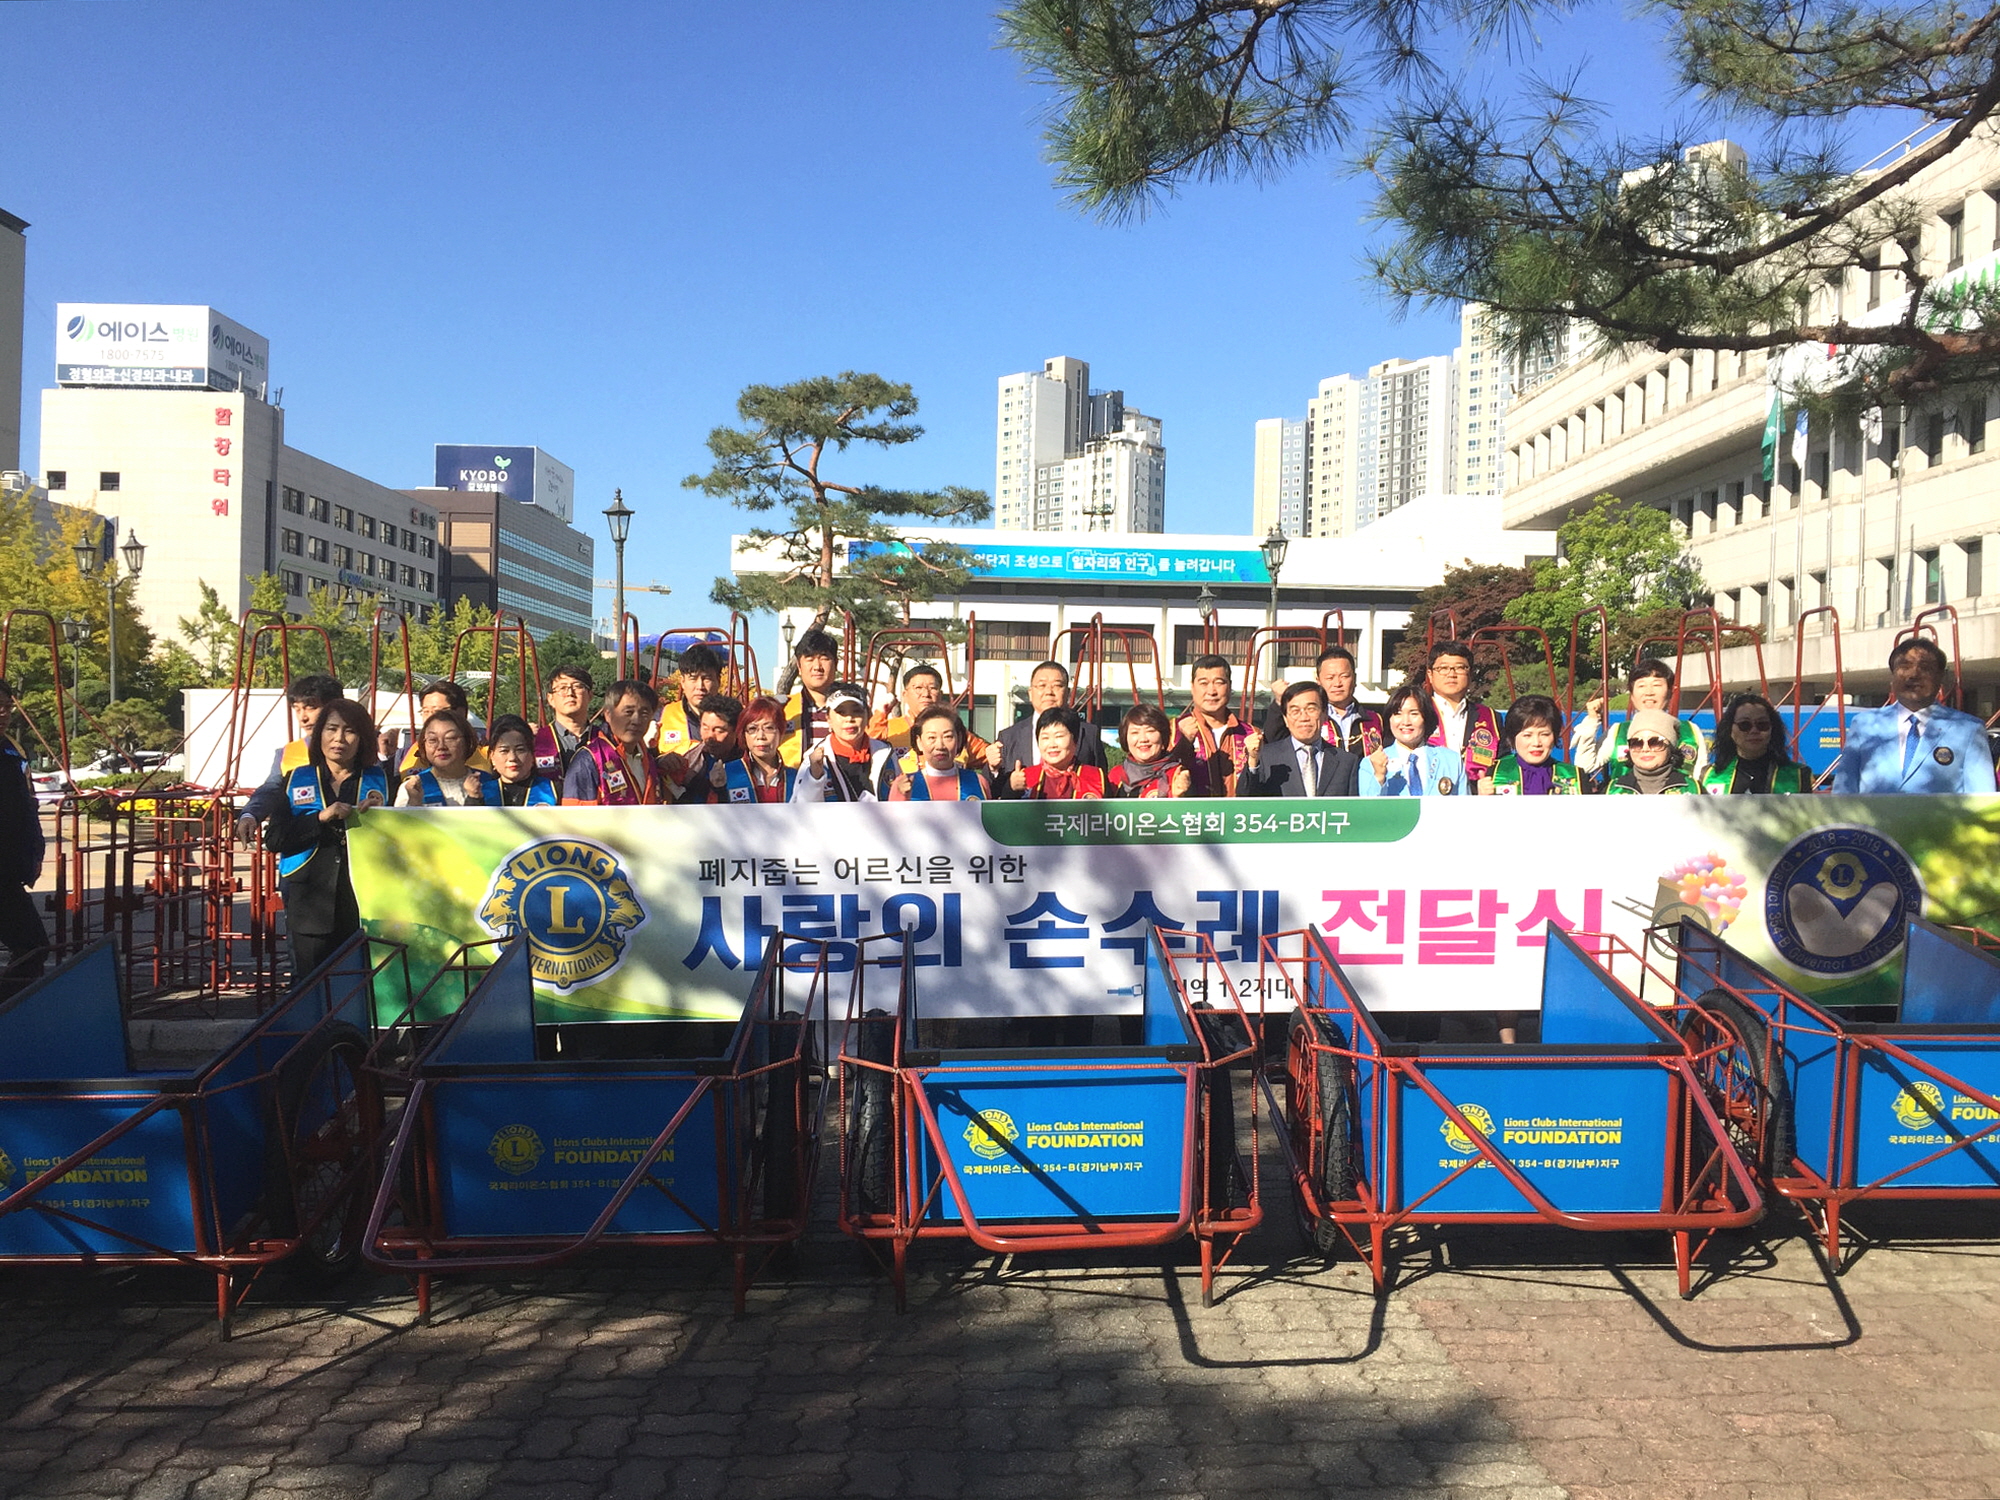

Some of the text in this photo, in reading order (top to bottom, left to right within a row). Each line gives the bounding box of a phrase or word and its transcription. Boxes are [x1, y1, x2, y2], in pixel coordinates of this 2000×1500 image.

[98, 321, 199, 342] 에이스 병원
[100, 349, 164, 361] 1800-7575
[225, 335, 253, 365] 에이스
[460, 469, 508, 482] KYOBO
[1014, 555, 1062, 570] 조성으로
[1072, 556, 1121, 571] 일자리와
[1125, 557, 1149, 571] 인구
[1158, 558, 1170, 571] 를
[1174, 558, 1236, 573] 늘려갑니다
[1045, 811, 1350, 838] 국제라이온스협회 354-B지구
[1805, 832, 1837, 853] 2018
[1851, 833, 1881, 853] 2019
[517, 846, 610, 877] LIONS
[698, 855, 1028, 888] 폐지줍는 어르신을 위한
[1767, 860, 1794, 907] District
[684, 888, 1604, 974] 사랑의 손수레 전달식
[1768, 910, 1791, 948] 354-B
[530, 949, 610, 976] TERNATIONAL
[1788, 947, 1846, 970] Governor
[1027, 1120, 1143, 1132] Lions Clubs International
[1503, 1118, 1622, 1127] Lions Clubs International
[554, 1137, 579, 1147] Lions
[582, 1137, 608, 1147] Clubs
[1027, 1134, 1143, 1148] FOUNDATION
[1503, 1131, 1621, 1144] FOUNDATION
[23, 1157, 50, 1167] Lions
[1043, 1162, 1144, 1173] 354-B(경기남부)지구
[1518, 1159, 1620, 1169] 354-B(경기남부)지구
